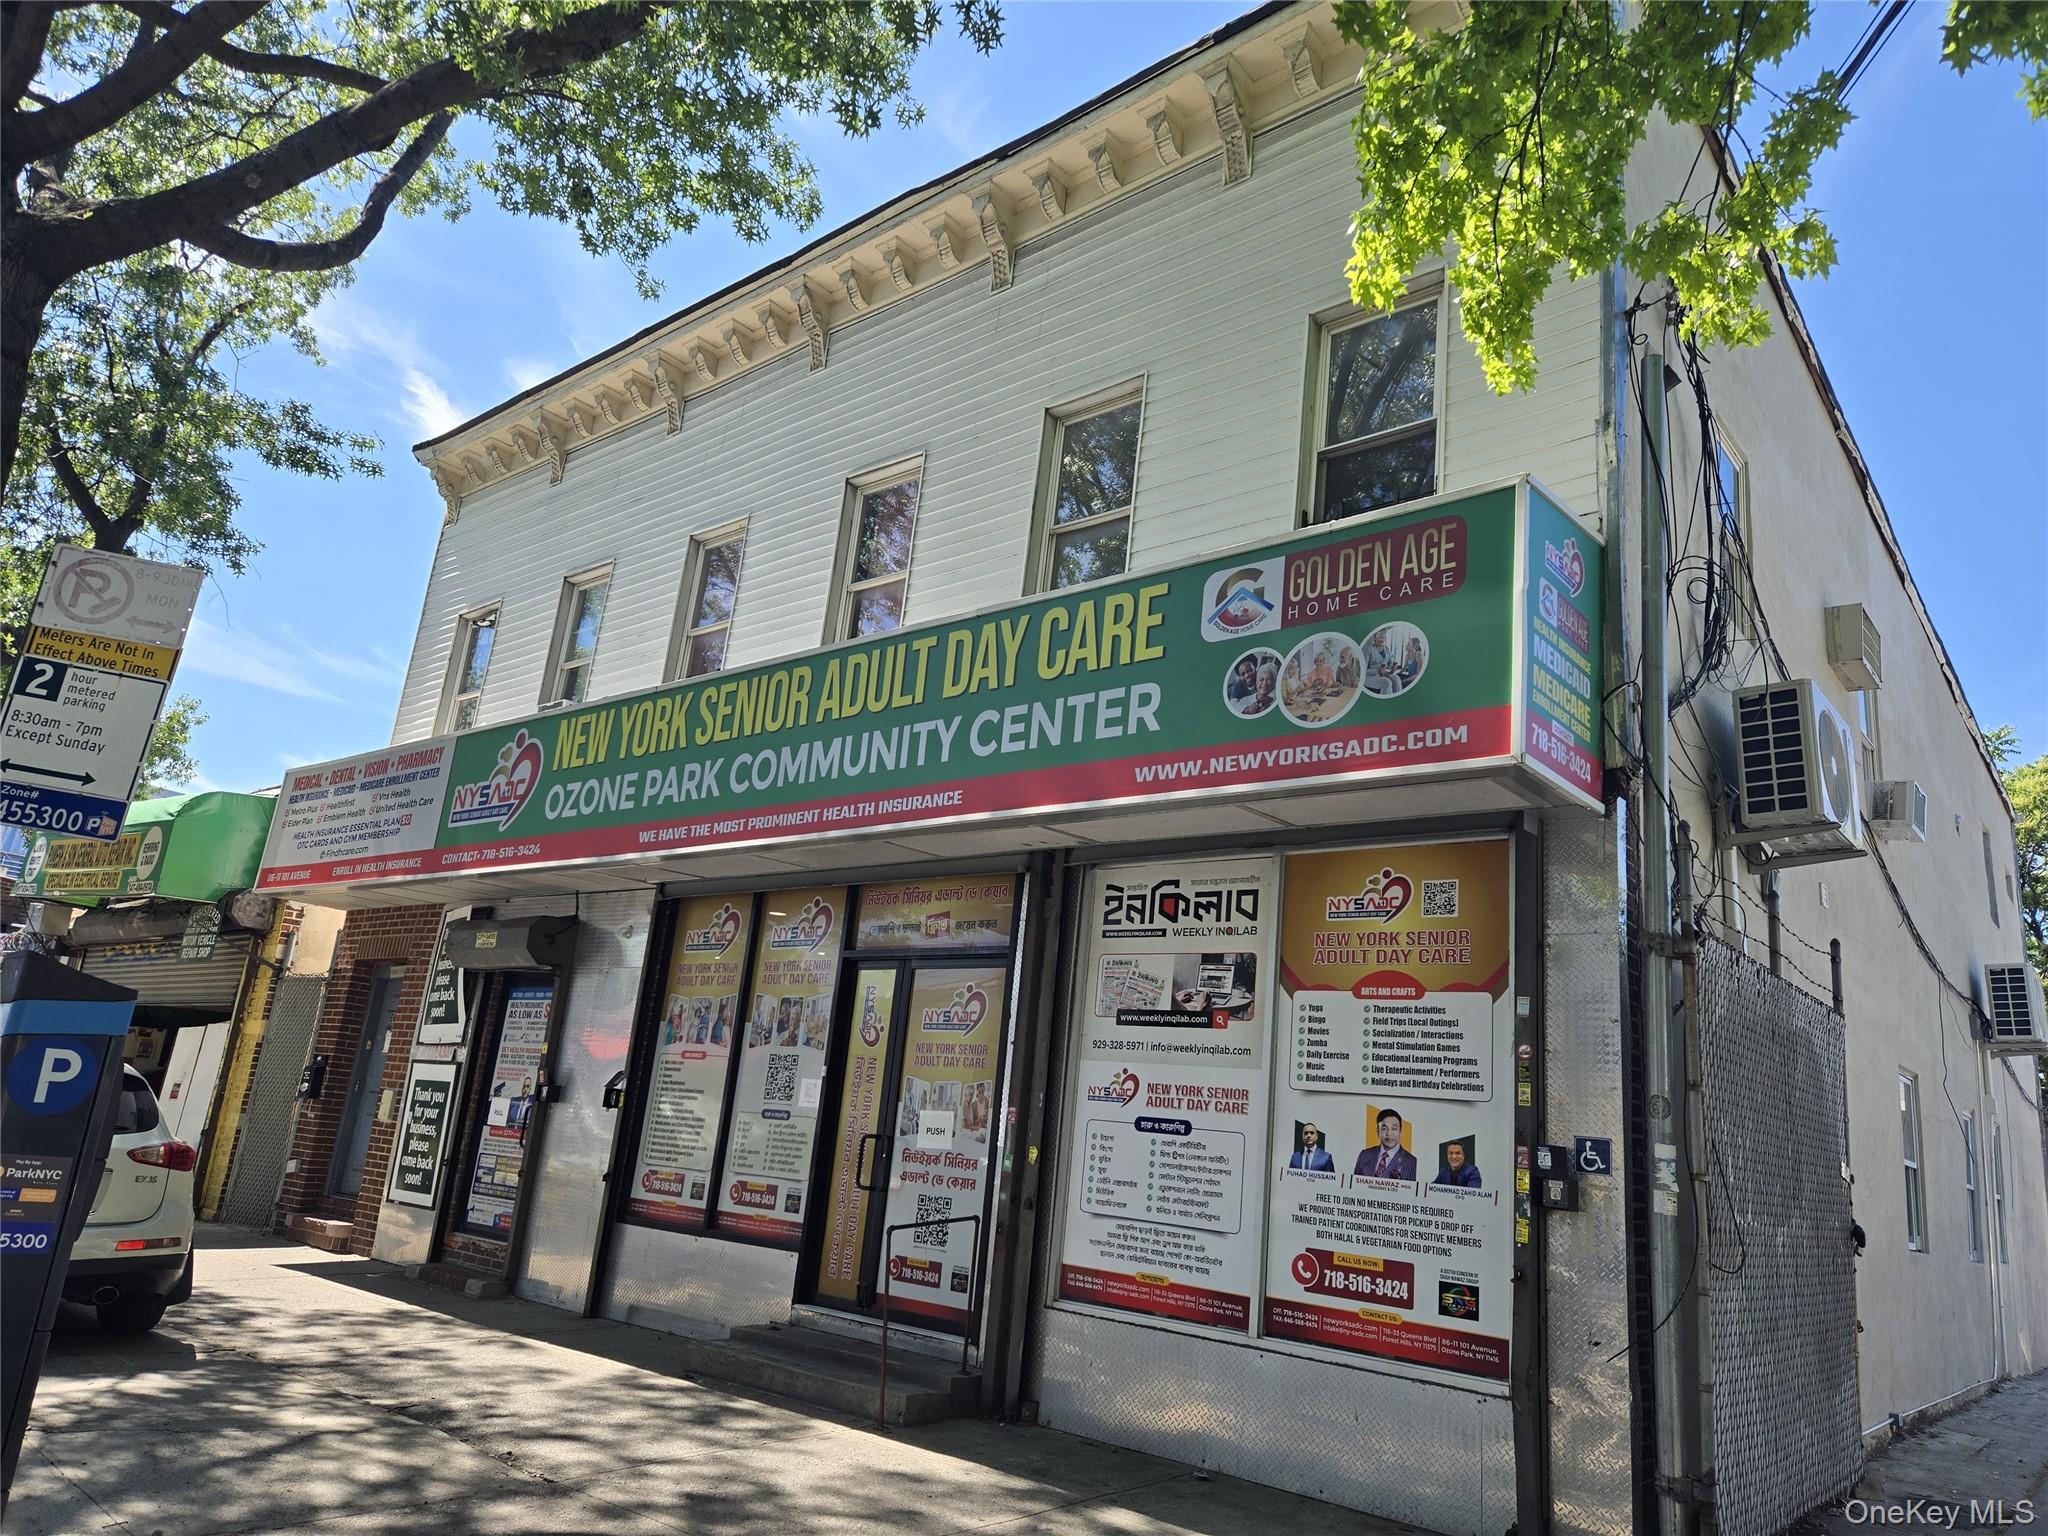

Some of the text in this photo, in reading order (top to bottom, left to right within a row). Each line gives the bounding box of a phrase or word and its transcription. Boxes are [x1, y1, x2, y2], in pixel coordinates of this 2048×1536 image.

[1289, 523, 1458, 602] GOLDEN AGE
[1288, 572, 1454, 619] HOME CARE
[40, 628, 154, 661] Meters Are Not In
[34, 642, 159, 678] Effect Above Times
[1534, 633, 1590, 699] MEDICAID
[26, 663, 54, 696] 2
[71, 672, 97, 685] hour
[552, 582, 1169, 771] NEW YORK SENIOR ADULT DAY CARE
[67, 684, 116, 701] metered
[1533, 664, 1591, 728] MEDICARE
[63, 696, 105, 712] parking
[11, 709, 61, 730] 8:30am
[77, 721, 102, 737] 7pm
[5, 725, 105, 755] Except Sunday
[545, 682, 1162, 820] OZONE PARK COMMUNITY CENTER
[1135, 724, 1468, 783] WWW.NEWYORKSADC.COM
[1532, 722, 1591, 783] 718-516-3424
[292, 746, 445, 792] MEDICAL DENTAL VISION PHARMACY
[2, 785, 39, 798] Zone#
[639, 790, 963, 843] WE HAVE THE MOST PROMINENT HEALTH INSURANCE
[482, 844, 540, 860] 718-516-3424
[1173, 926, 1257, 937] WEEKLY INQILAB
[1314, 929, 1471, 948] NEW YORK SENIOR
[1313, 949, 1471, 965] ADULT DAY CARE
[1392, 987, 1416, 996] CRAFTS
[1309, 1004, 1323, 1013] Yoga
[1373, 1005, 1446, 1015] Therapeutic Activities
[1120, 1014, 1208, 1024] www.weeklyinqilab.com
[1308, 1016, 1326, 1024] Bingo
[1373, 1017, 1388, 1025] Field
[1390, 1018, 1406, 1027] Trips
[1308, 1027, 1329, 1036] Movies
[1372, 1029, 1415, 1038] Socialization
[1421, 1030, 1463, 1040] Interactions
[1092, 1040, 1251, 1056] 929-328-5971 info@weeklyinqilab.com
[1307, 1039, 1327, 1047] Zumba
[1372, 1041, 1460, 1052] Mental Stimulation Games
[1307, 1050, 1350, 1060] Daily Exercise
[1372, 1053, 1478, 1066] Educational Learning Programs
[1306, 1062, 1325, 1070] Music
[1372, 1065, 1384, 1074] Live
[1386, 1066, 1433, 1076] Entertainment
[1439, 1068, 1480, 1079] Performers
[33, 1047, 82, 1103] P
[1306, 1074, 1344, 1083] Biofeedback
[1147, 1083, 1249, 1100] NEW YORK SENIOR
[1371, 1077, 1484, 1092] Holidays and Birthday Celebrations
[415, 1087, 445, 1105] Thank you
[414, 1103, 439, 1123] for your
[1146, 1096, 1248, 1114] ADULT DAY CARE
[409, 1120, 437, 1137] business,
[926, 1127, 945, 1135] PUSH
[408, 1136, 429, 1153] please
[402, 1155, 433, 1170] come back
[6, 1167, 62, 1180] ParkNYC
[404, 1172, 422, 1185] soon!
[1316, 1193, 1453, 1218] FREE TO JOIN NO MEMBERSHIP IS REQUIRED
[1299, 1203, 1474, 1234] WE PROVIDE TRANSPORTATION FOR PICKUP & DROP OFF
[1292, 1215, 1482, 1248] TRAINED PATIENT COORDINATORS FOR SENSITIVE MEMBERS
[1316, 1230, 1452, 1257] BOTH HALAL & VEGETARIAN FOOD OPTIONS
[1324, 1269, 1408, 1300] 718-516-3424
